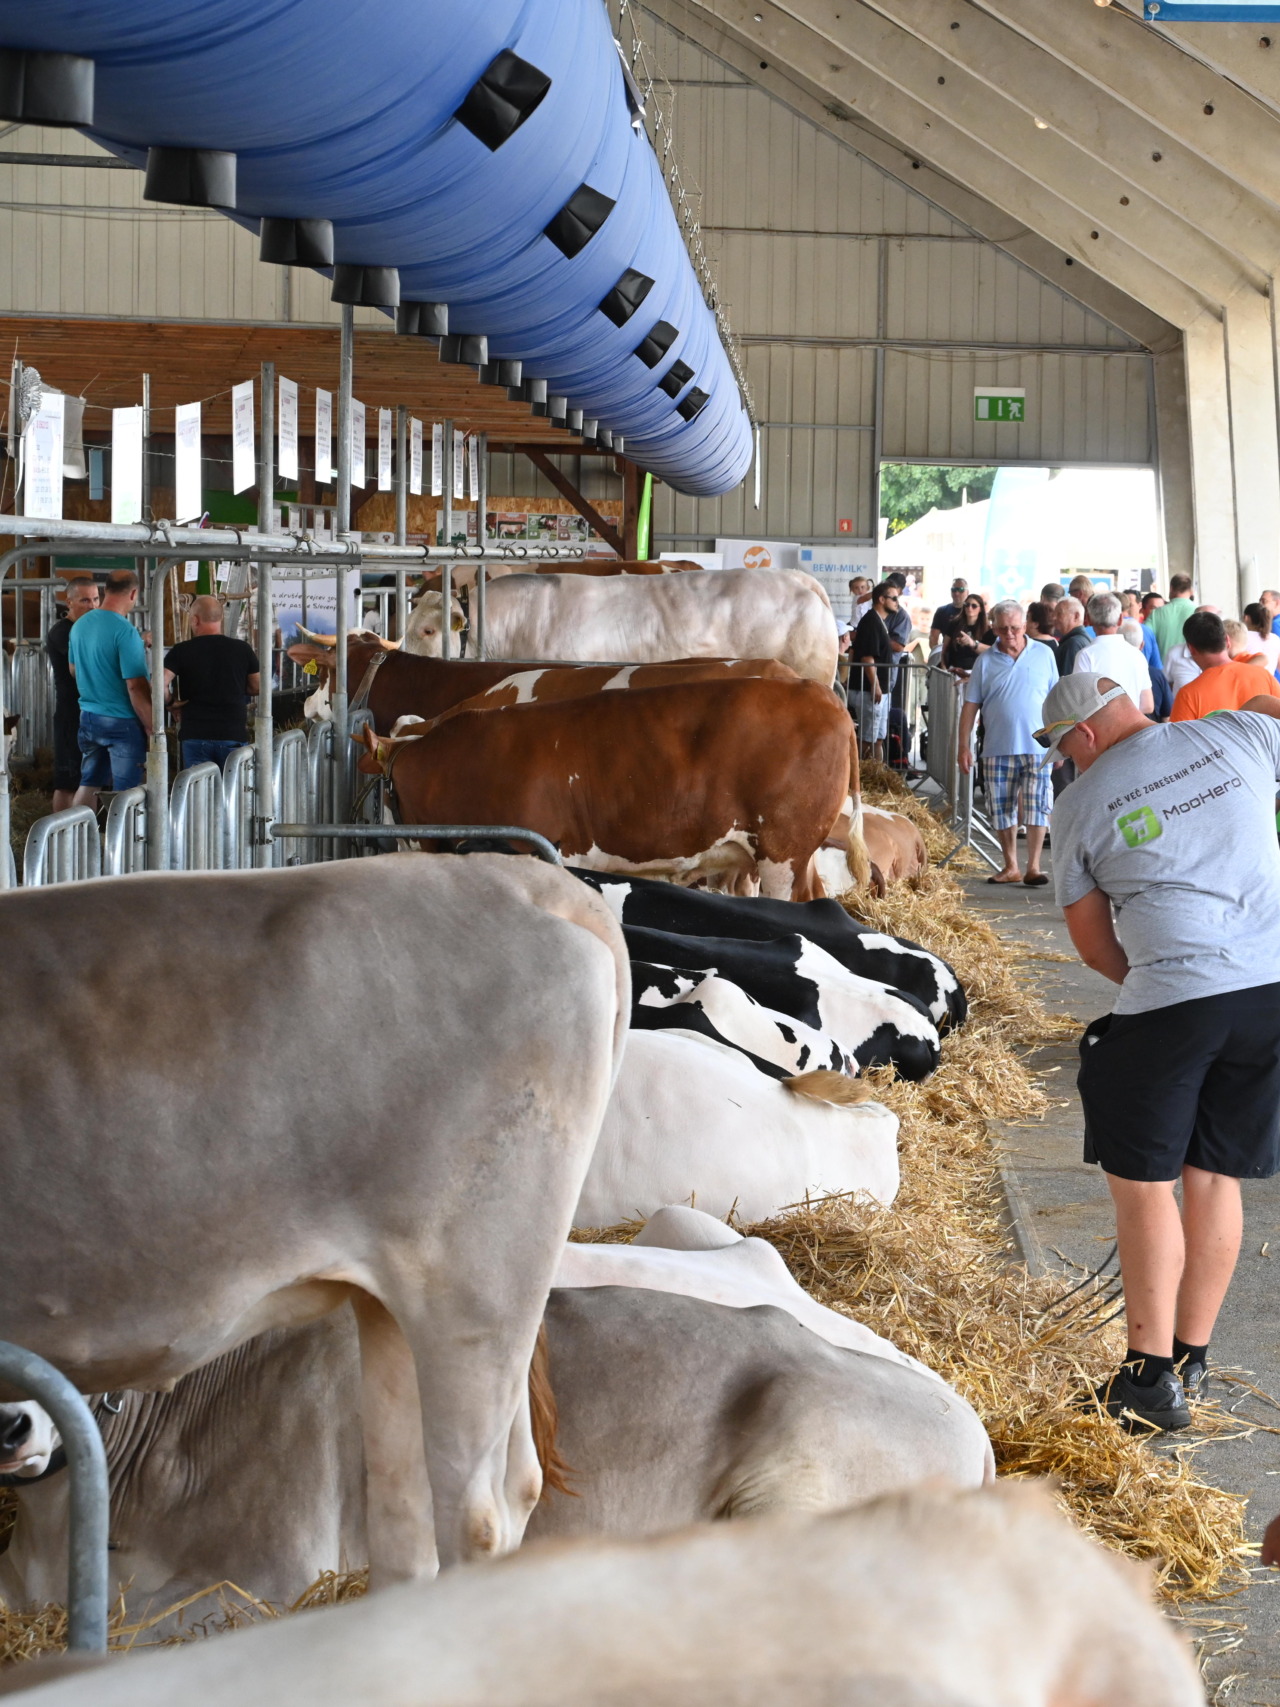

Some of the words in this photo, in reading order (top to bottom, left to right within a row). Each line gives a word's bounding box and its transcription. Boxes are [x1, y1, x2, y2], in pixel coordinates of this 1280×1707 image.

[1107, 796, 1124, 812] NIČ
[1124, 787, 1143, 803] VEČ
[1143, 768, 1190, 795] ZGREŠENIH
[1190, 748, 1225, 772] POJATEV
[1162, 777, 1242, 820] MooHero
